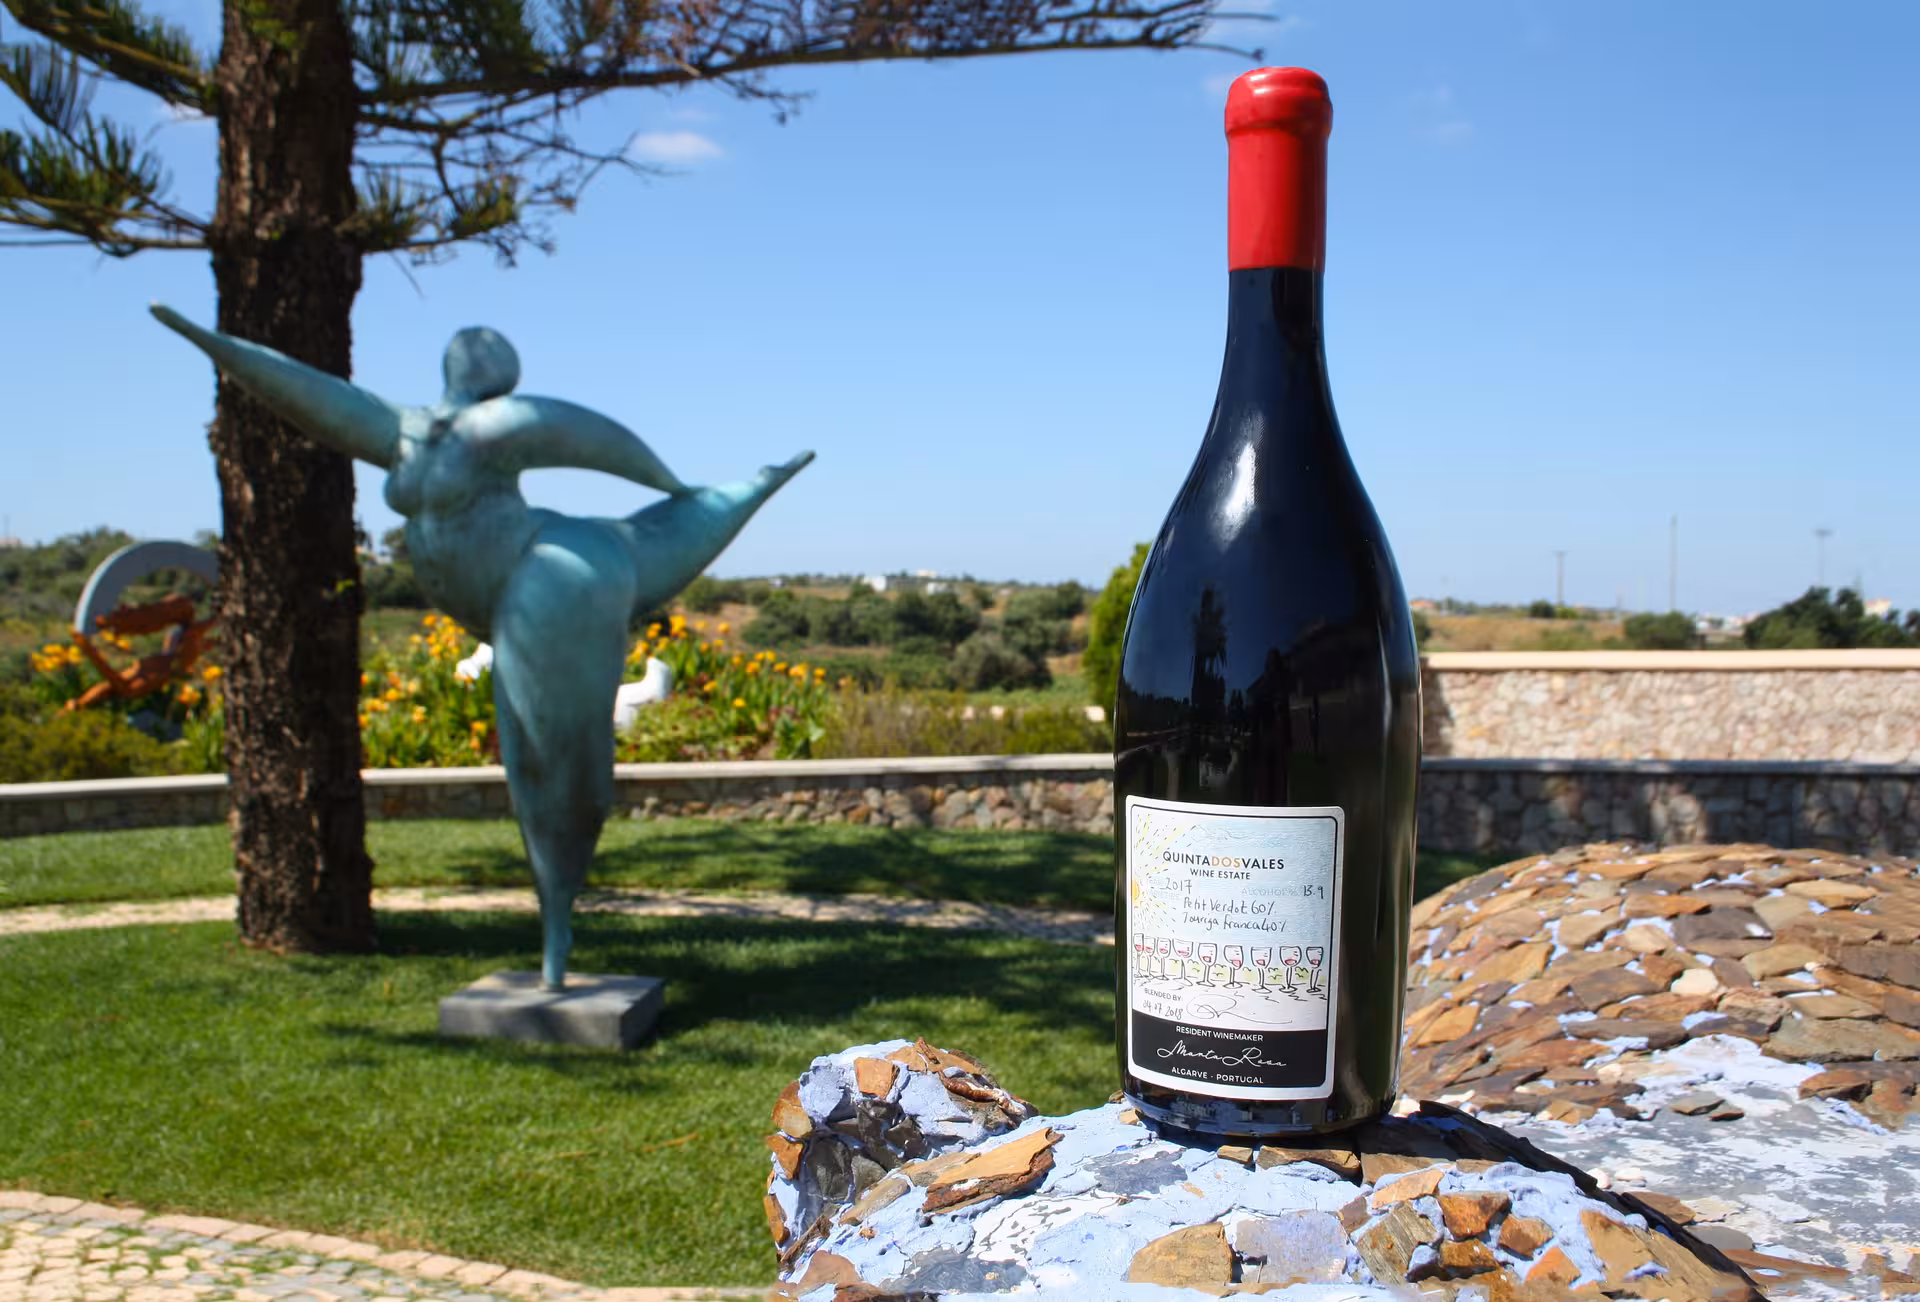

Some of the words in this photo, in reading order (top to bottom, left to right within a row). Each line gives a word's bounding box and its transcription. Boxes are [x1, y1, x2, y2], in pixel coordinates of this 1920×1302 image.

[1162, 850, 1285, 870] QUINTADOSVALES
[1190, 867, 1215, 878] WINE
[1217, 869, 1251, 880] ESTATE
[1164, 876, 1193, 895] 2017
[1183, 896, 1207, 912] Petit
[1209, 898, 1248, 915] Verdot
[1144, 987, 1171, 1000] BLENDED
[1175, 1025, 1212, 1039] RESIDENT
[1212, 1031, 1264, 1042] WINEMAKER
[1171, 1066, 1208, 1079] ALGARVE
[1216, 1073, 1264, 1084] PORTUGAL
